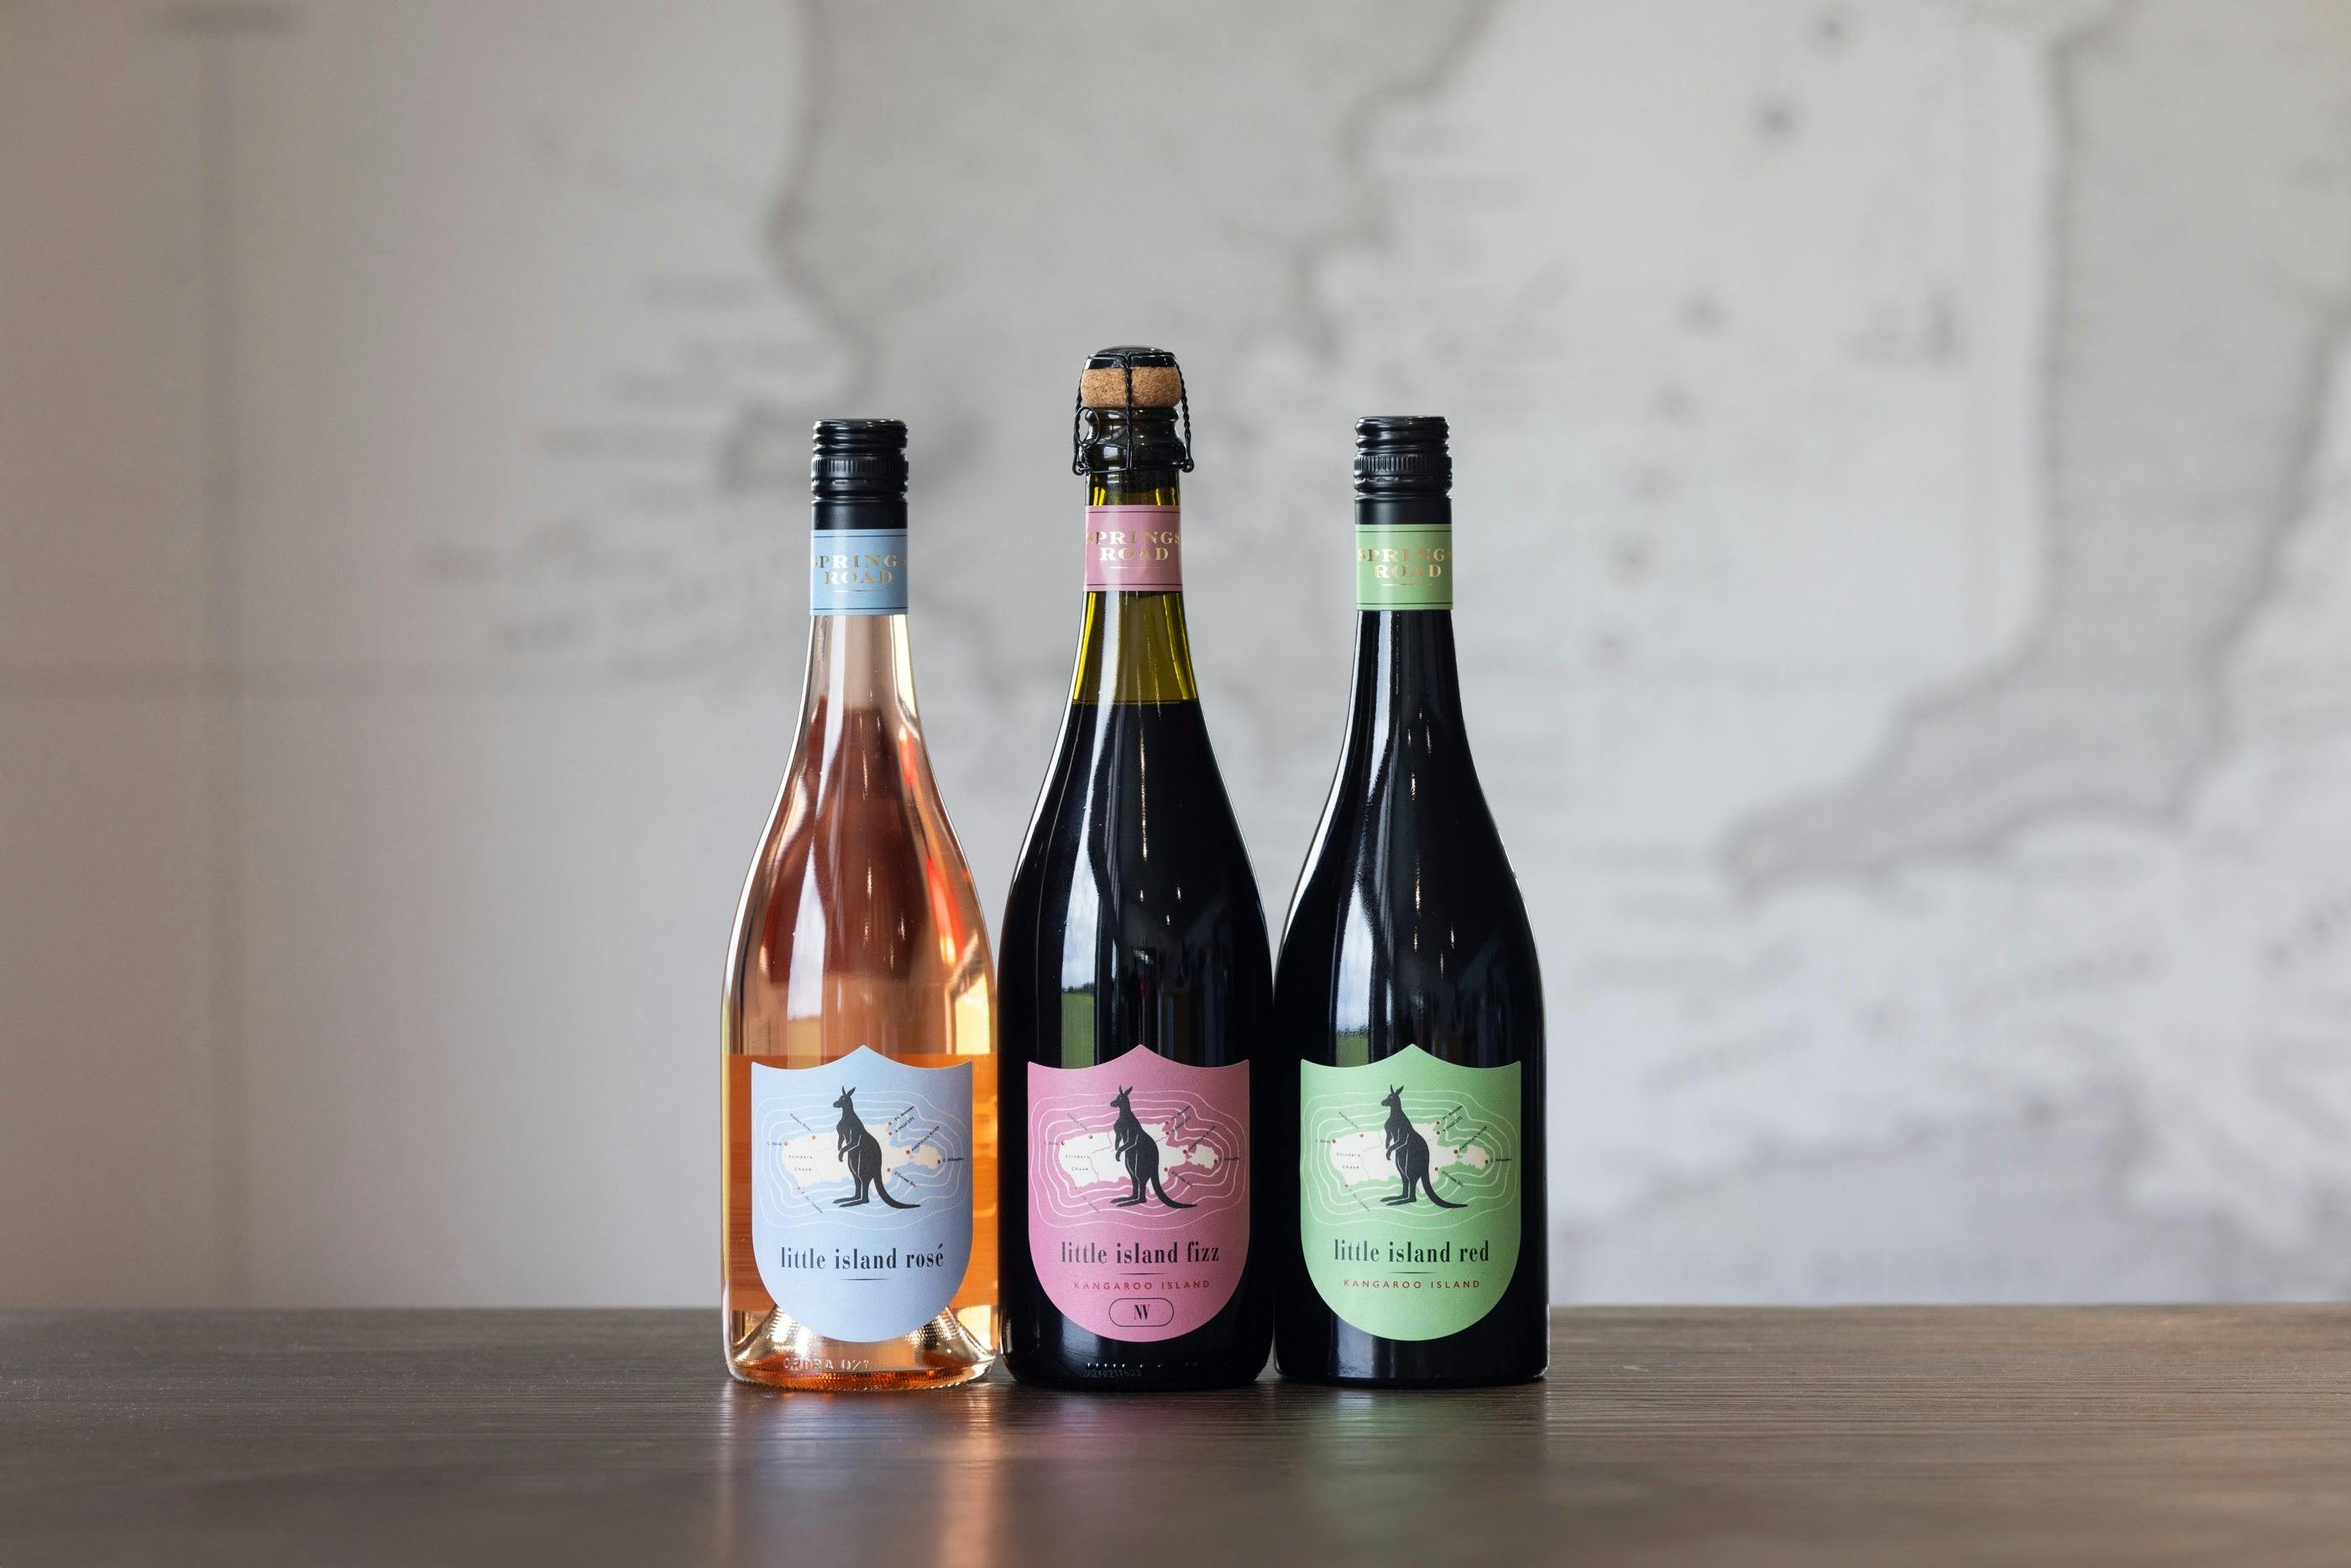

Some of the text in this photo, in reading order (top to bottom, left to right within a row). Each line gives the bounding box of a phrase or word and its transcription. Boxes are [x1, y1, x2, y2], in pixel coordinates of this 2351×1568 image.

[1100, 547, 1169, 561] ROAD
[825, 571, 893, 585] ROAD
[1374, 564, 1442, 578] ROAD
[781, 1243, 944, 1269] little island rosé
[1061, 1241, 1220, 1264] little island fizz
[1334, 1239, 1490, 1262] little island red
[1073, 1280, 1210, 1290] KANGAROO ISLAND
[1343, 1278, 1480, 1289] KANGAROO ISLAND
[1134, 1304, 1150, 1320] NV
